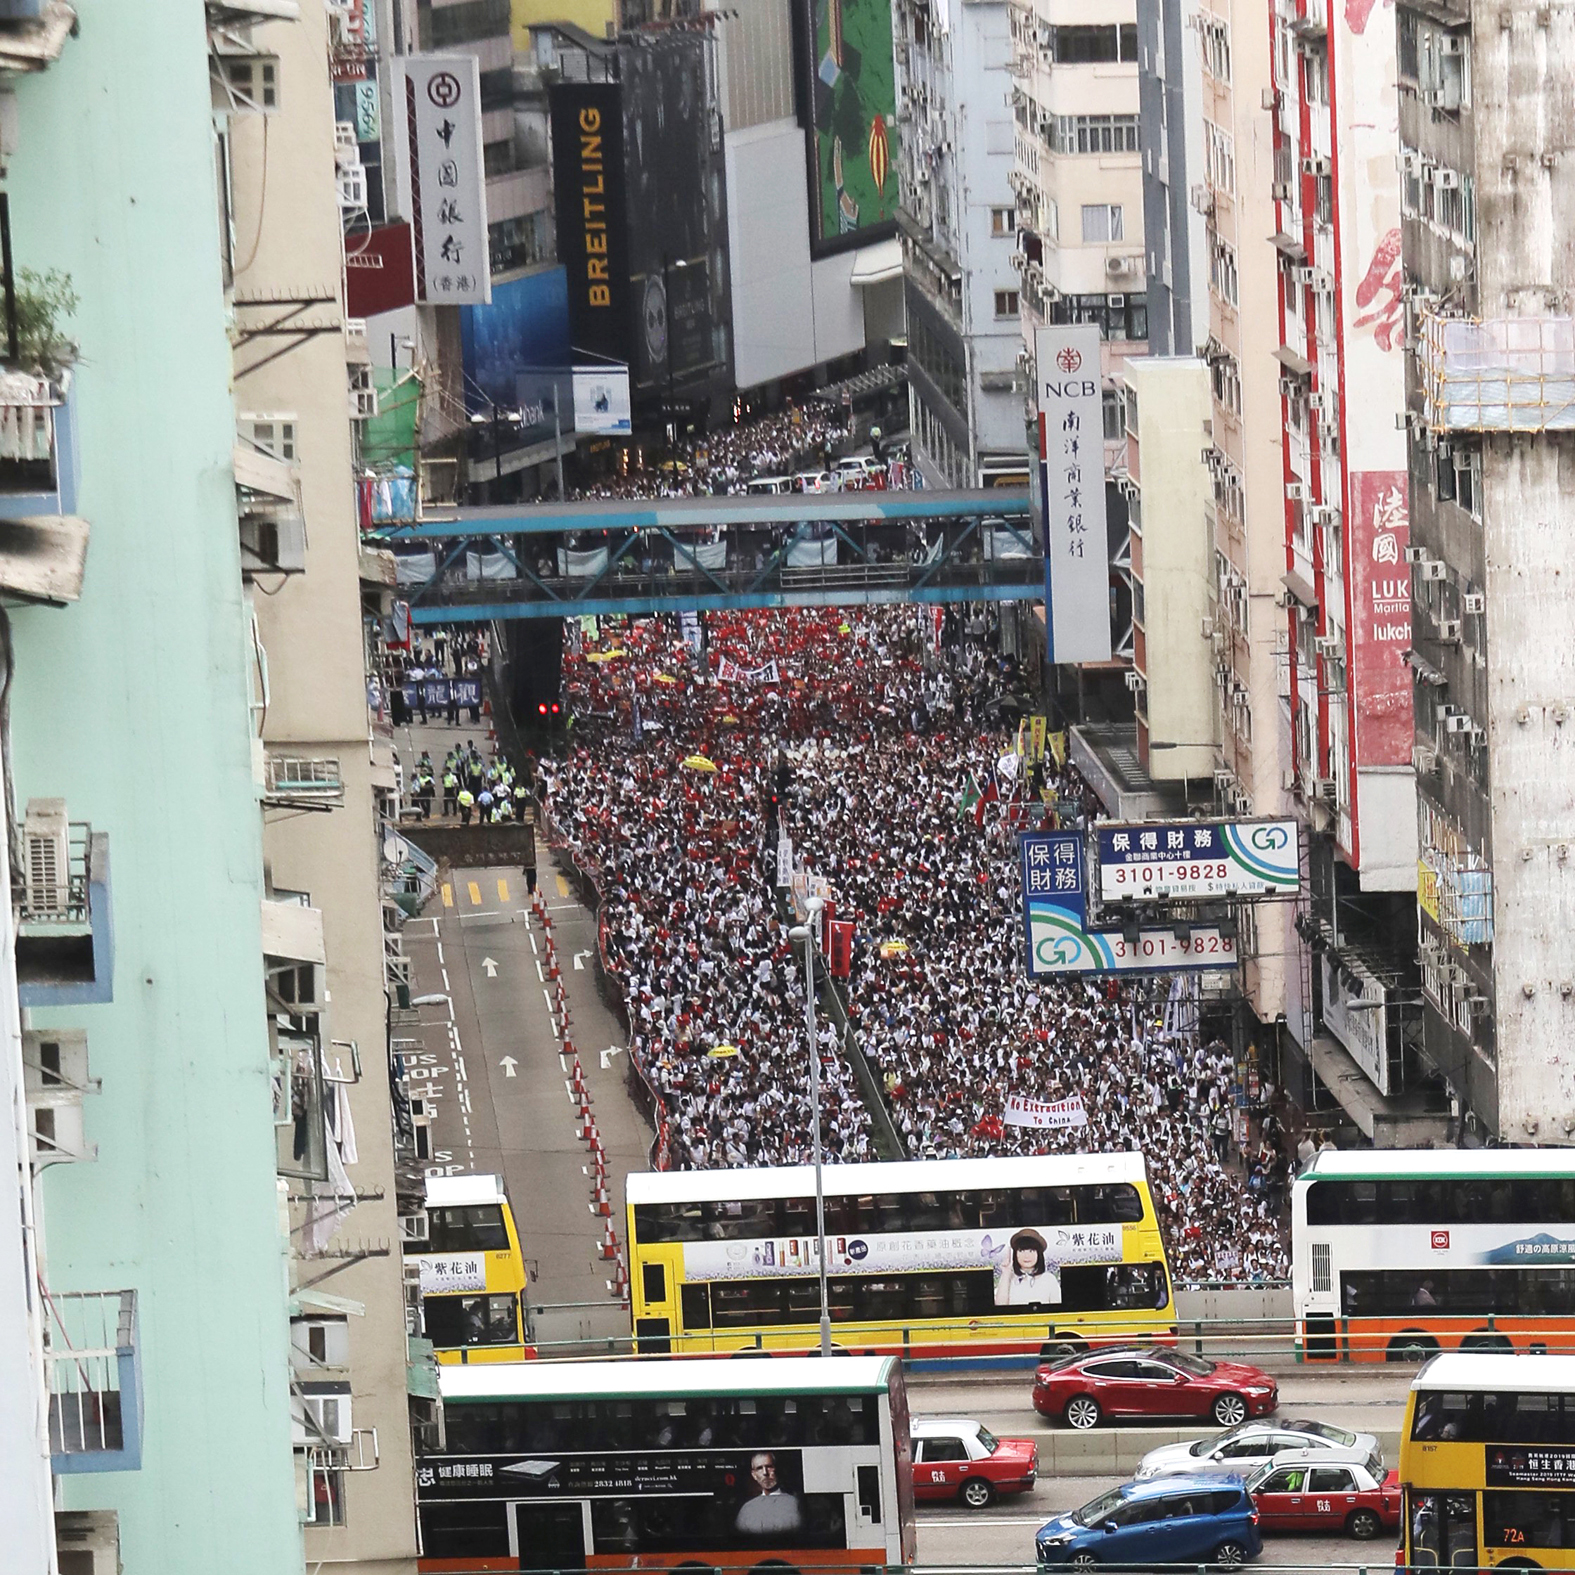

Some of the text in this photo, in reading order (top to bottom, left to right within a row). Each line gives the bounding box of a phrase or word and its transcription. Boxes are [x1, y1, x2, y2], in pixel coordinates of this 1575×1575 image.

[436, 118, 465, 265] 中國銀行
[579, 107, 610, 307] BREITLING
[432, 273, 477, 293] (香港)
[1045, 381, 1096, 399] NCB
[1062, 410, 1088, 558] 南洋商業銀行
[1372, 580, 1409, 599] LUK
[1112, 829, 1212, 852] 保得財務
[1029, 843, 1075, 867] 保得
[1031, 867, 1077, 891] 財務
[1115, 863, 1228, 883] 3101-9828
[1011, 1097, 1080, 1113] No Extradition
[1033, 1116, 1042, 1125] To
[1072, 1232, 1115, 1246] 紫花油
[434, 1261, 478, 1276] 紫花油
[1503, 1527, 1525, 1543] 72A
